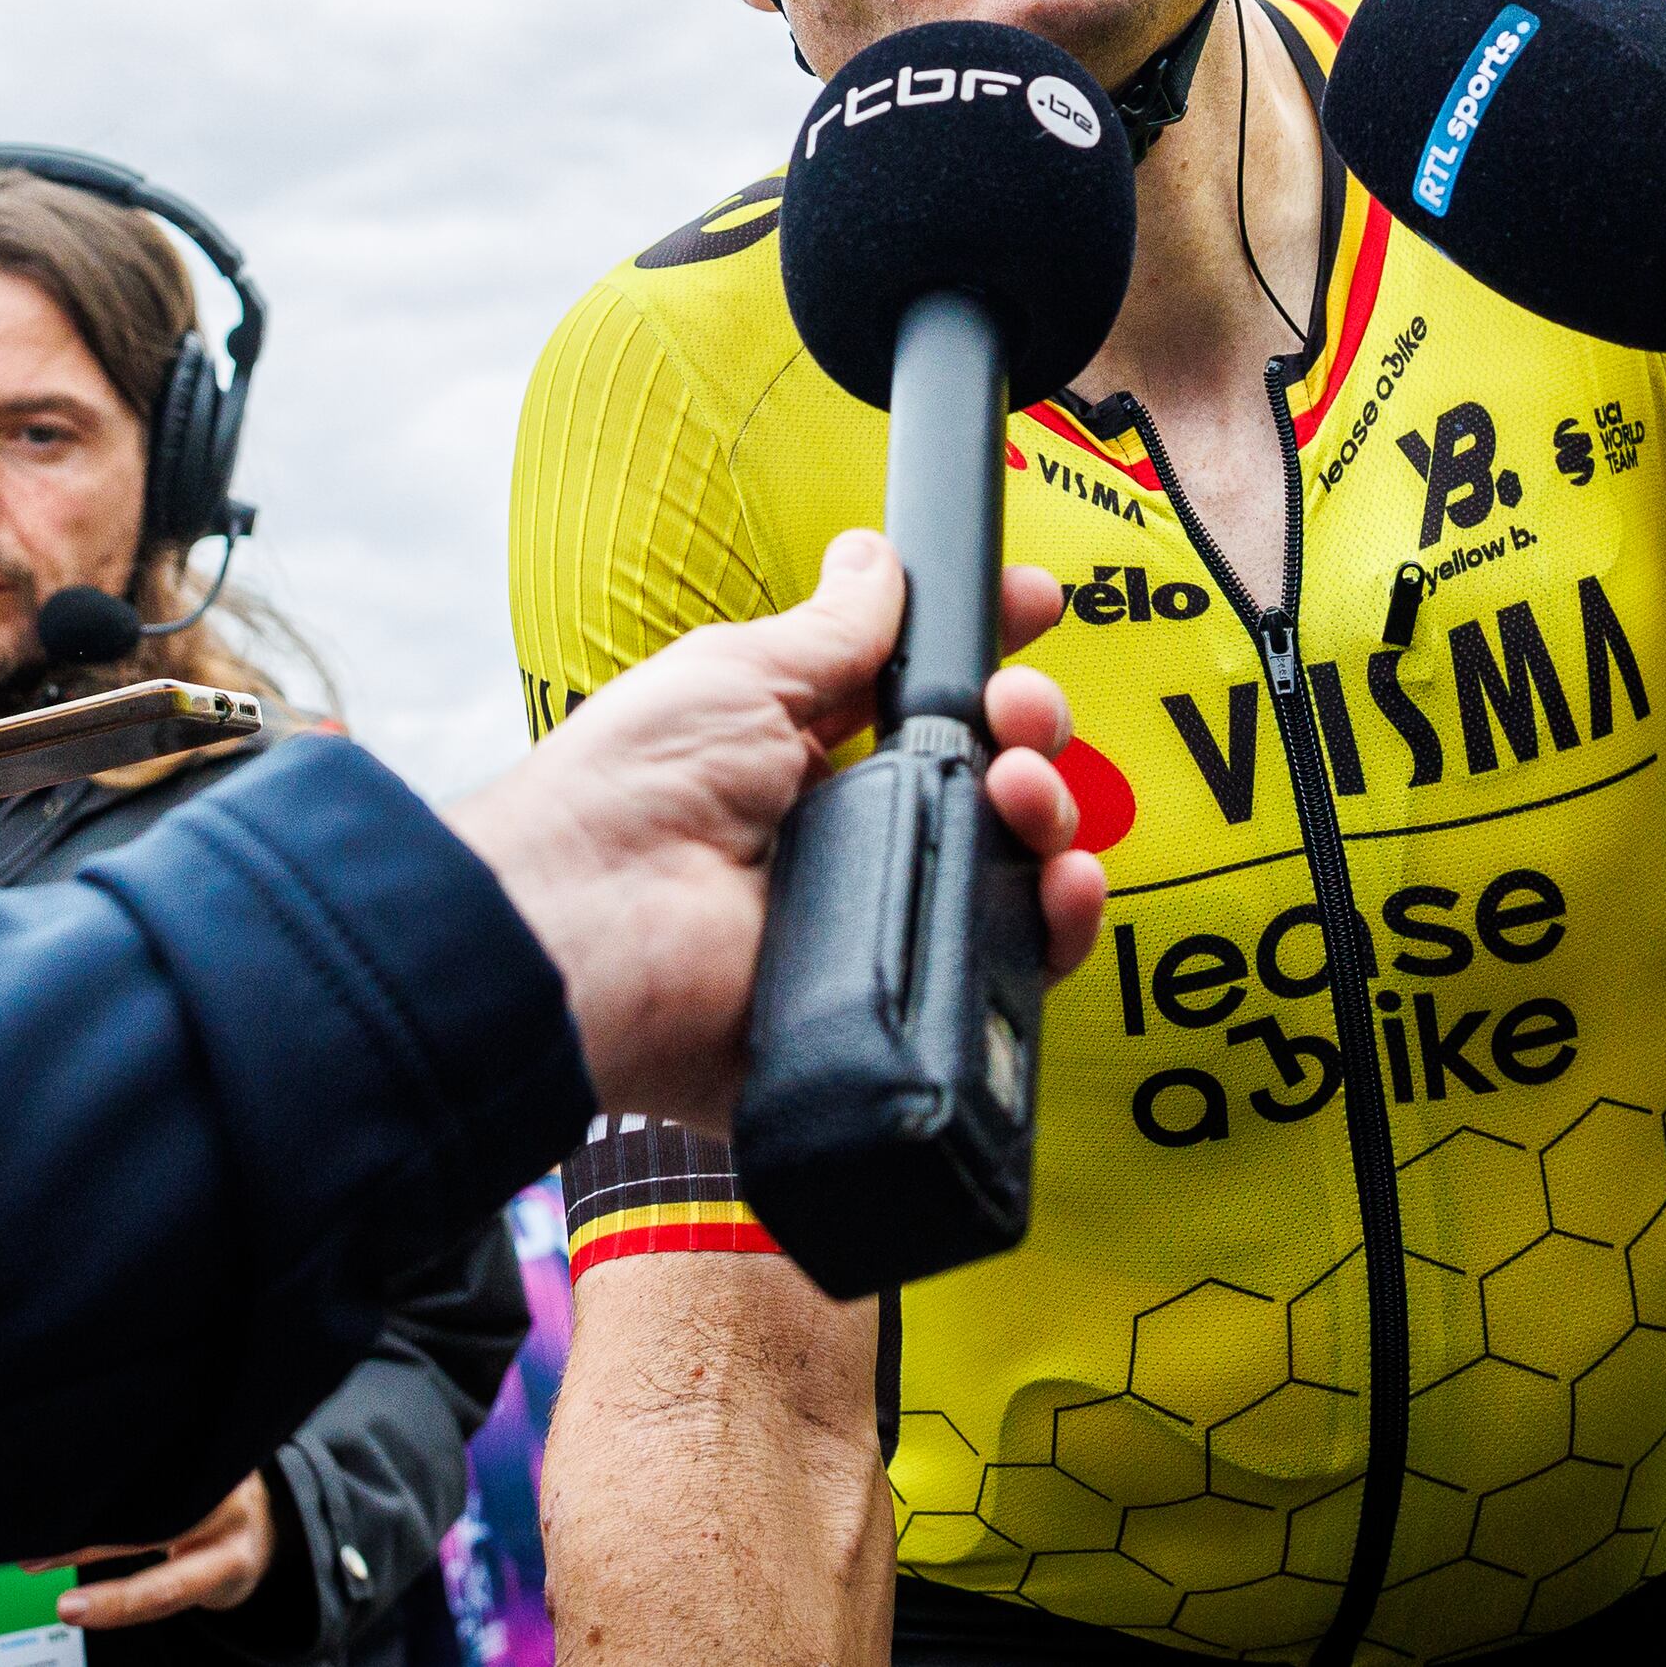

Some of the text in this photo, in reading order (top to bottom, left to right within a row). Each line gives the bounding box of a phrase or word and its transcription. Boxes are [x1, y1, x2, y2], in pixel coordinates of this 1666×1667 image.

[1419, 145, 1459, 208] RTL
[1318, 400, 1378, 493] lease
[1594, 401, 1623, 429] UCI
[1599, 421, 1645, 452] WORLD
[1038, 452, 1145, 528] VISMA
[1605, 445, 1639, 475] TEAM
[1424, 536, 1505, 598] yellow
[1160, 575, 1652, 826] VISMA
[1113, 868, 1569, 1036] lease
